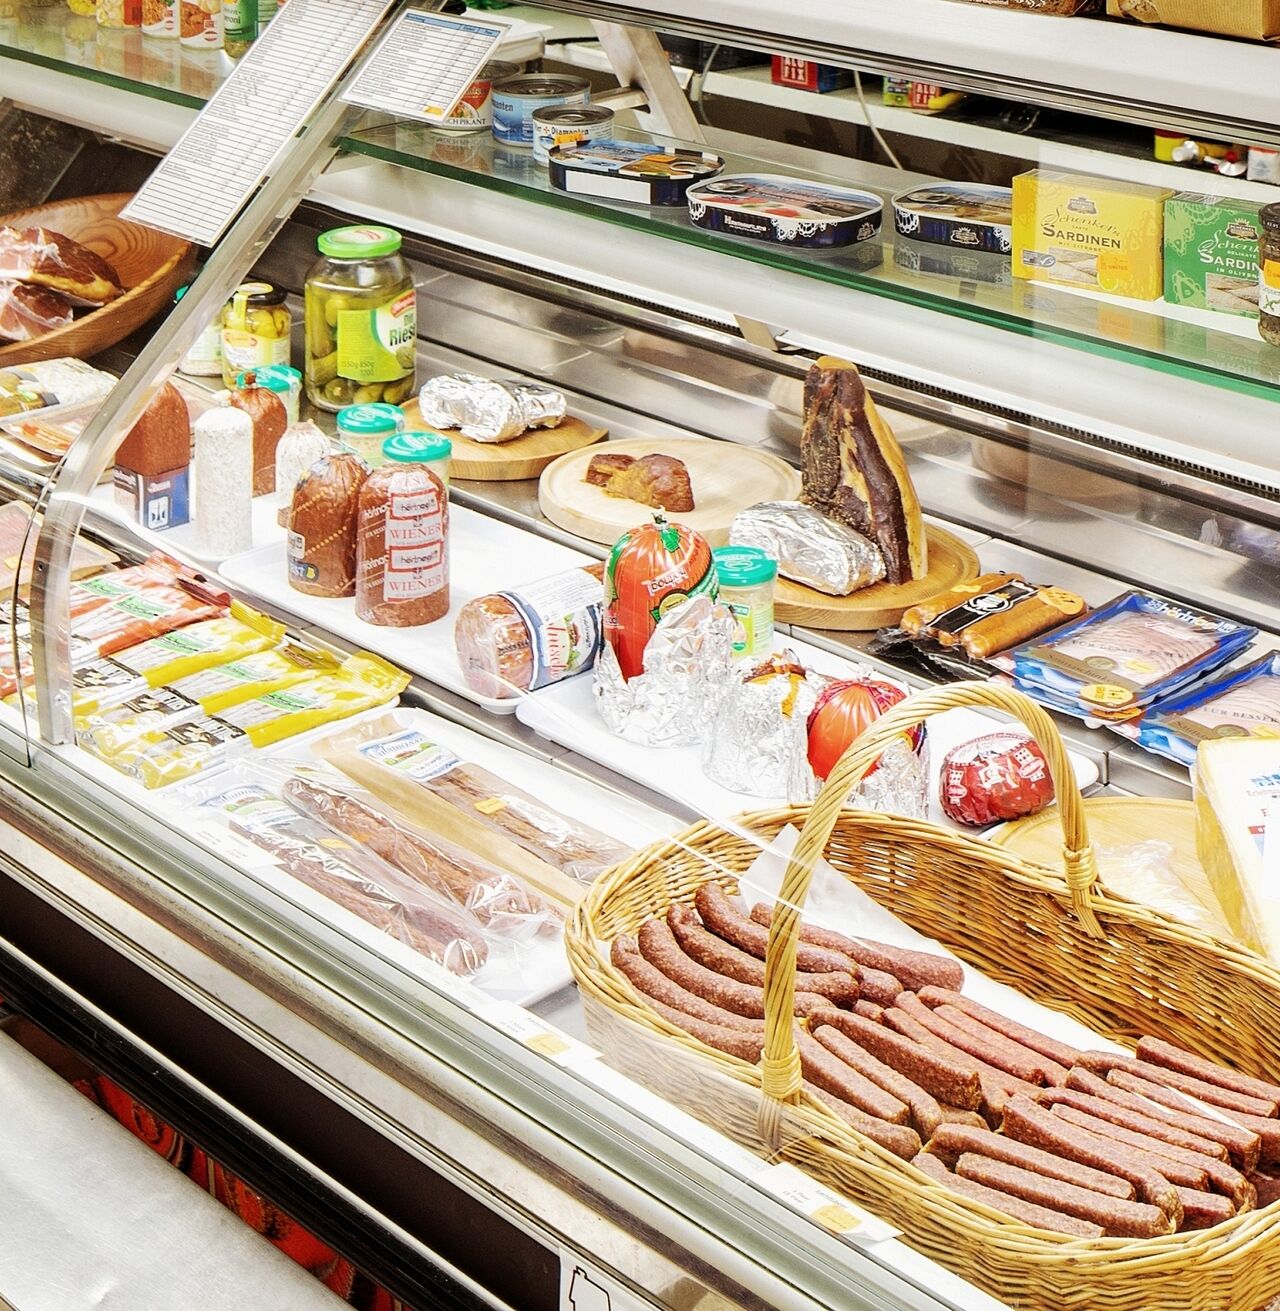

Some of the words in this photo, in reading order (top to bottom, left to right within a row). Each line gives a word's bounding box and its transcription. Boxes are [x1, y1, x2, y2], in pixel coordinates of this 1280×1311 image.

[783, 67, 806, 85] FIX
[461, 118, 486, 126] PIKANT
[1042, 223, 1122, 250] SARDINEN
[389, 523, 441, 540] WIENER
[388, 574, 442, 592] WIENER
